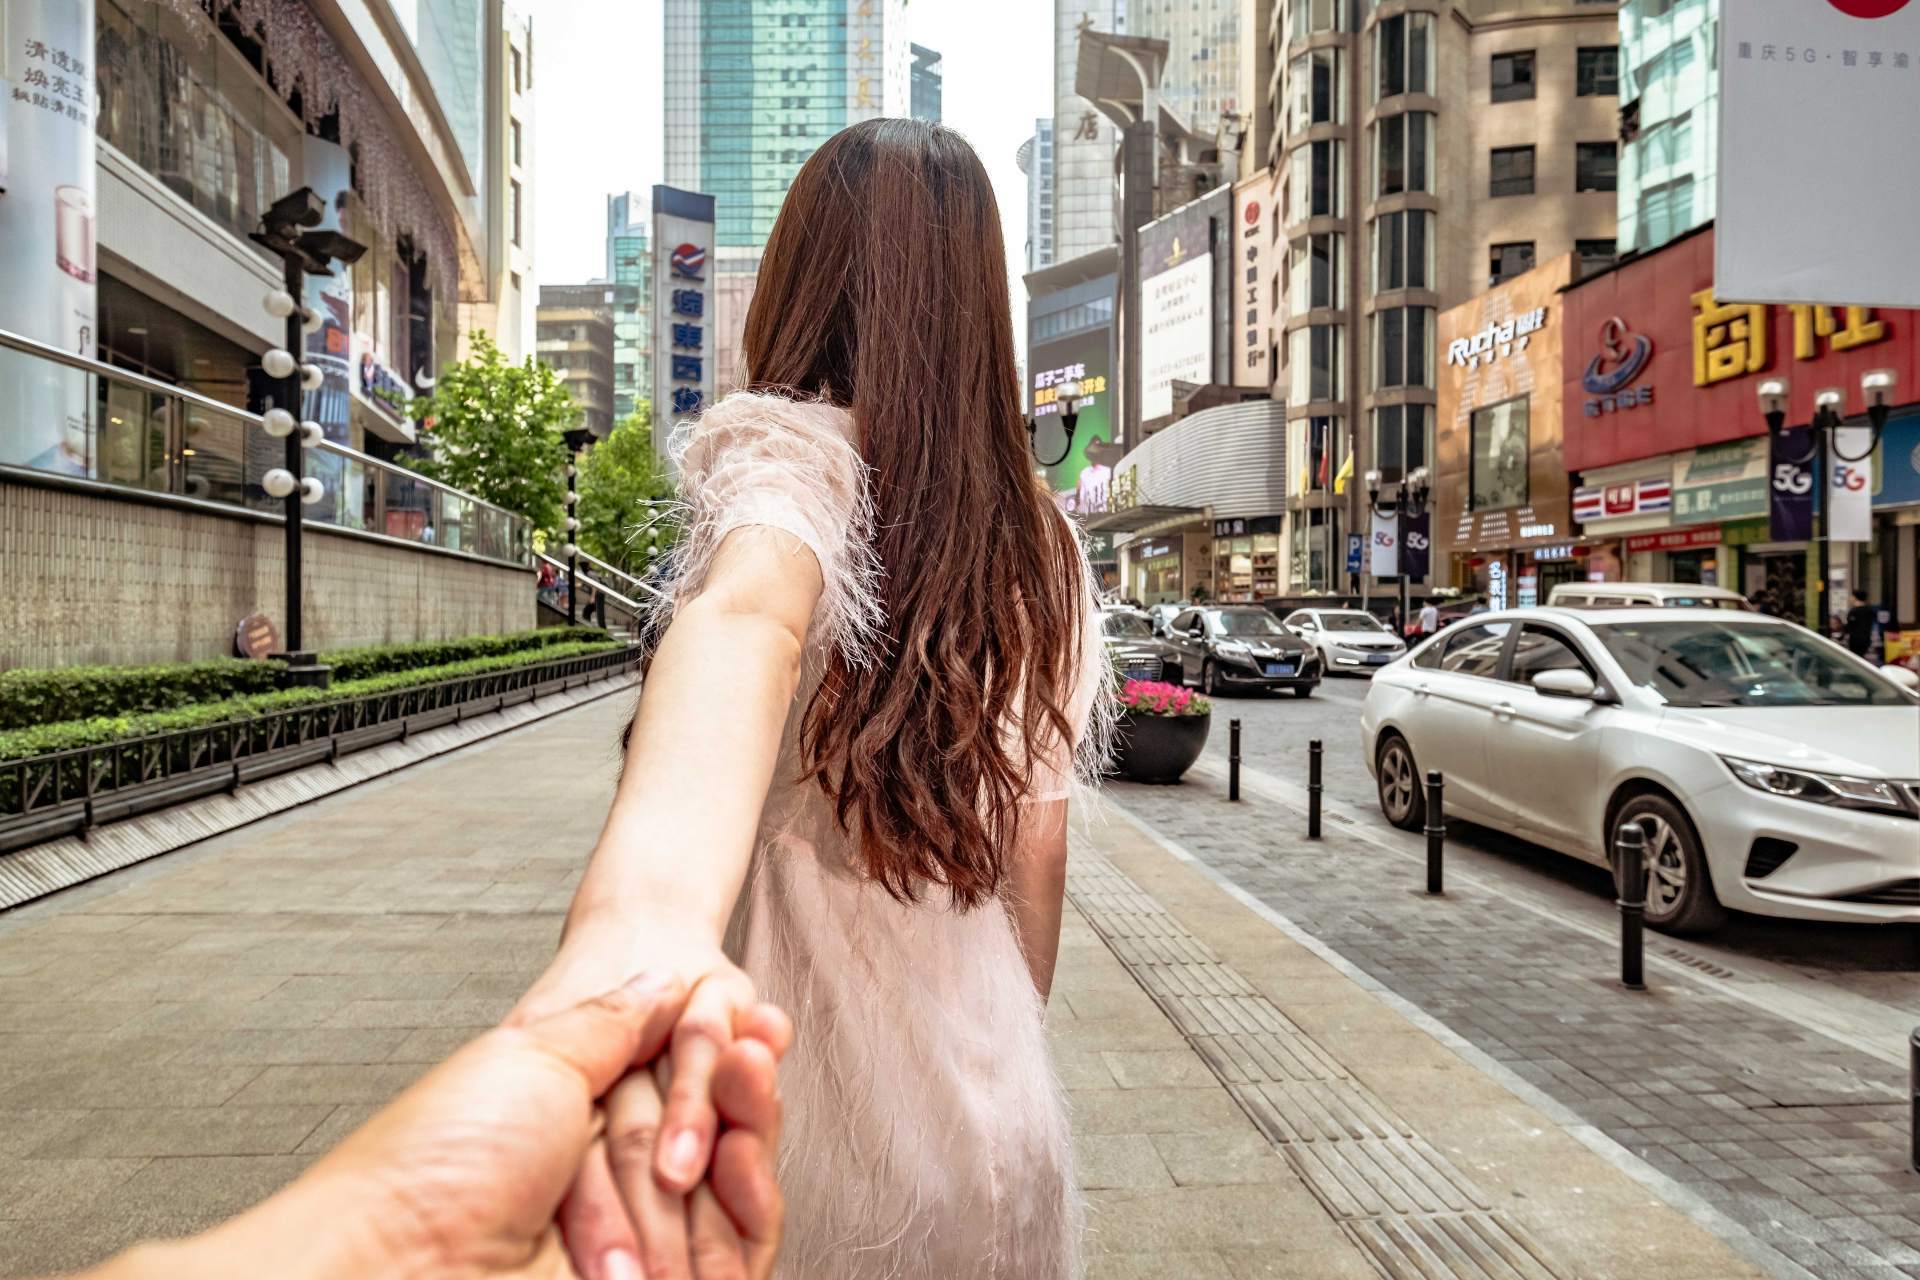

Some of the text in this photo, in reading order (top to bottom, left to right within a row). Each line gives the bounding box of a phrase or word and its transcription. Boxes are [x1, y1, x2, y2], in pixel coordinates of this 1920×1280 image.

[1773, 463, 1813, 495] 5G
[1832, 466, 1865, 492] 5G
[1374, 531, 1395, 549] 5G
[1406, 531, 1430, 551] 5G
